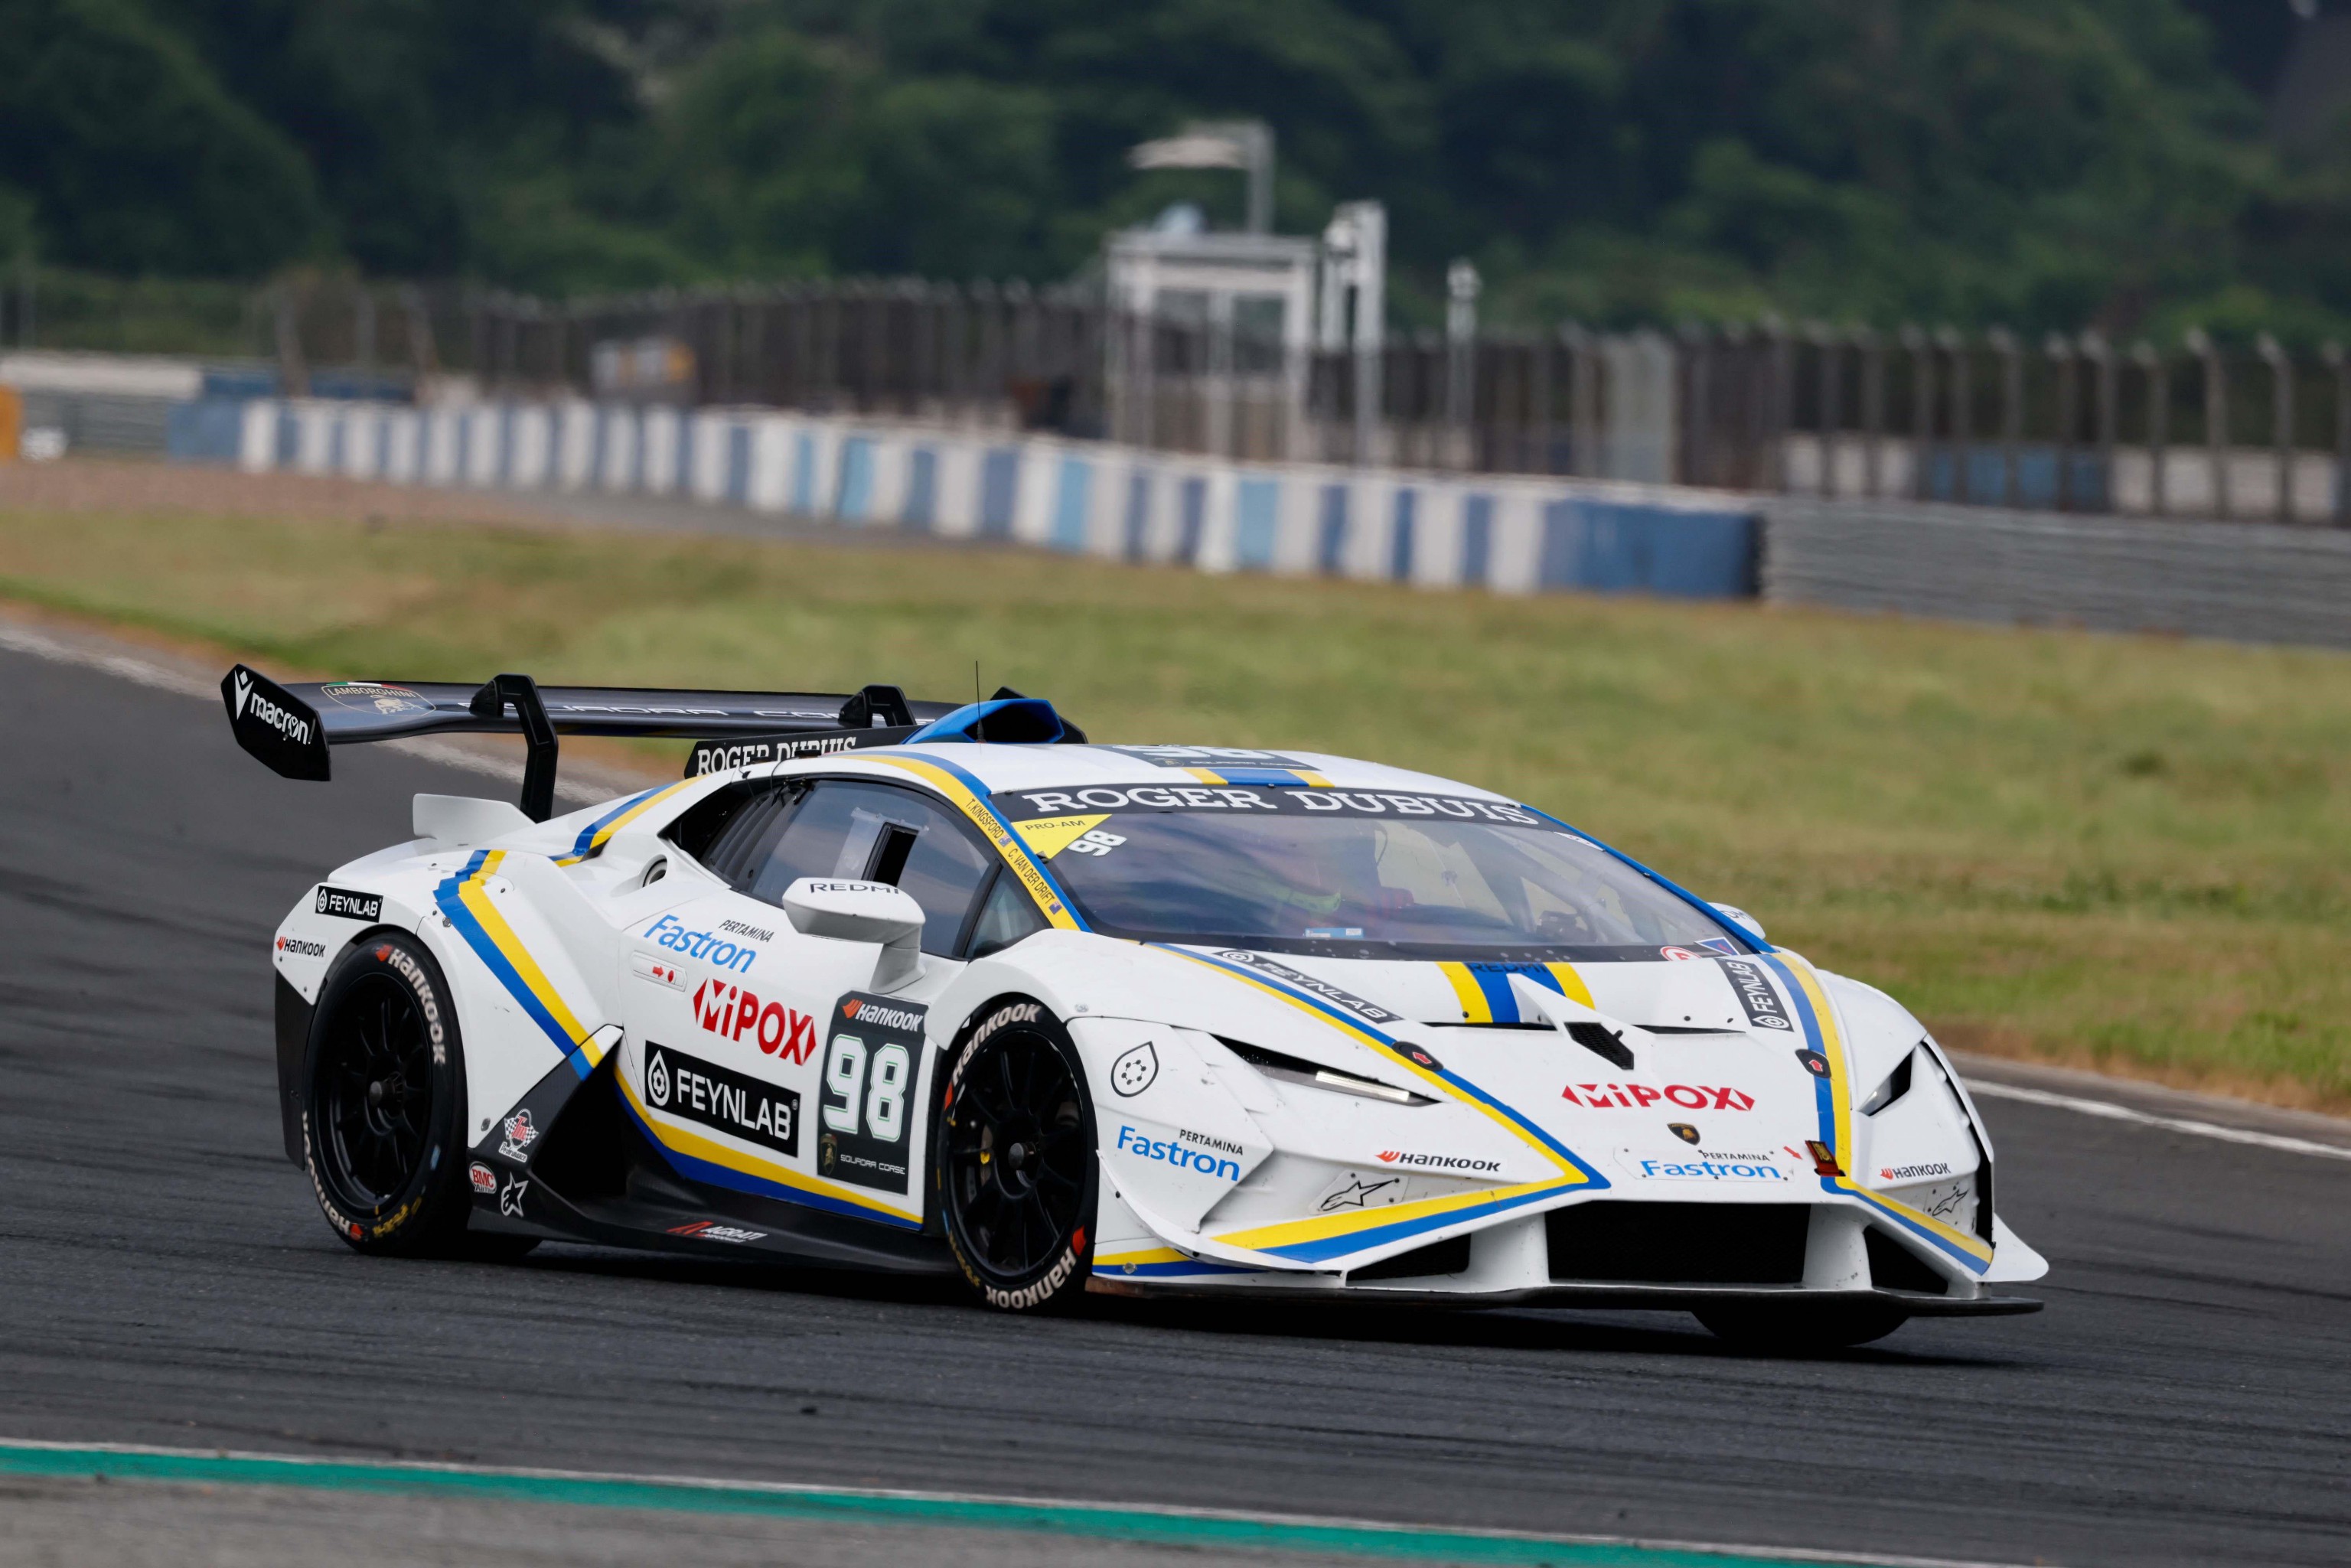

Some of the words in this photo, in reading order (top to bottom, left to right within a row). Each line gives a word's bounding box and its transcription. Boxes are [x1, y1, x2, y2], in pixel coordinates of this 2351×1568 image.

[327, 686, 417, 699] LAMBORGHINI
[249, 692, 308, 745] macron
[1022, 787, 1278, 813] ROGER
[1284, 791, 1539, 825] DUBUIS
[1025, 820, 1087, 831] PRO-AM
[1007, 847, 1016, 859] C.
[1067, 830, 1127, 856] 98
[1011, 855, 1029, 876] VAN
[1024, 868, 1039, 887] DER
[810, 883, 899, 895] REDMI
[1034, 881, 1056, 905] DRIFT
[328, 894, 379, 918] FEYNLAB
[644, 914, 757, 974] Fastron
[718, 919, 775, 944] PERTAMINA
[1254, 962, 1387, 1019] FEYNLAB
[1726, 961, 1778, 1014] FEYNLAB
[693, 976, 817, 1067] MiPOX
[823, 1033, 910, 1143] 98
[1561, 1083, 1756, 1111] MiPOX
[677, 1068, 792, 1141] FEYNLAB
[1117, 1125, 1241, 1182] Fastron
[1179, 1129, 1244, 1156] PERTAMINA
[840, 1154, 877, 1169] SQUADRA
[879, 1162, 906, 1175] CORSE
[1639, 1160, 1782, 1178] Fastron
[1702, 1152, 1771, 1162] PERTAMINA
[471, 1169, 495, 1188] BMC
